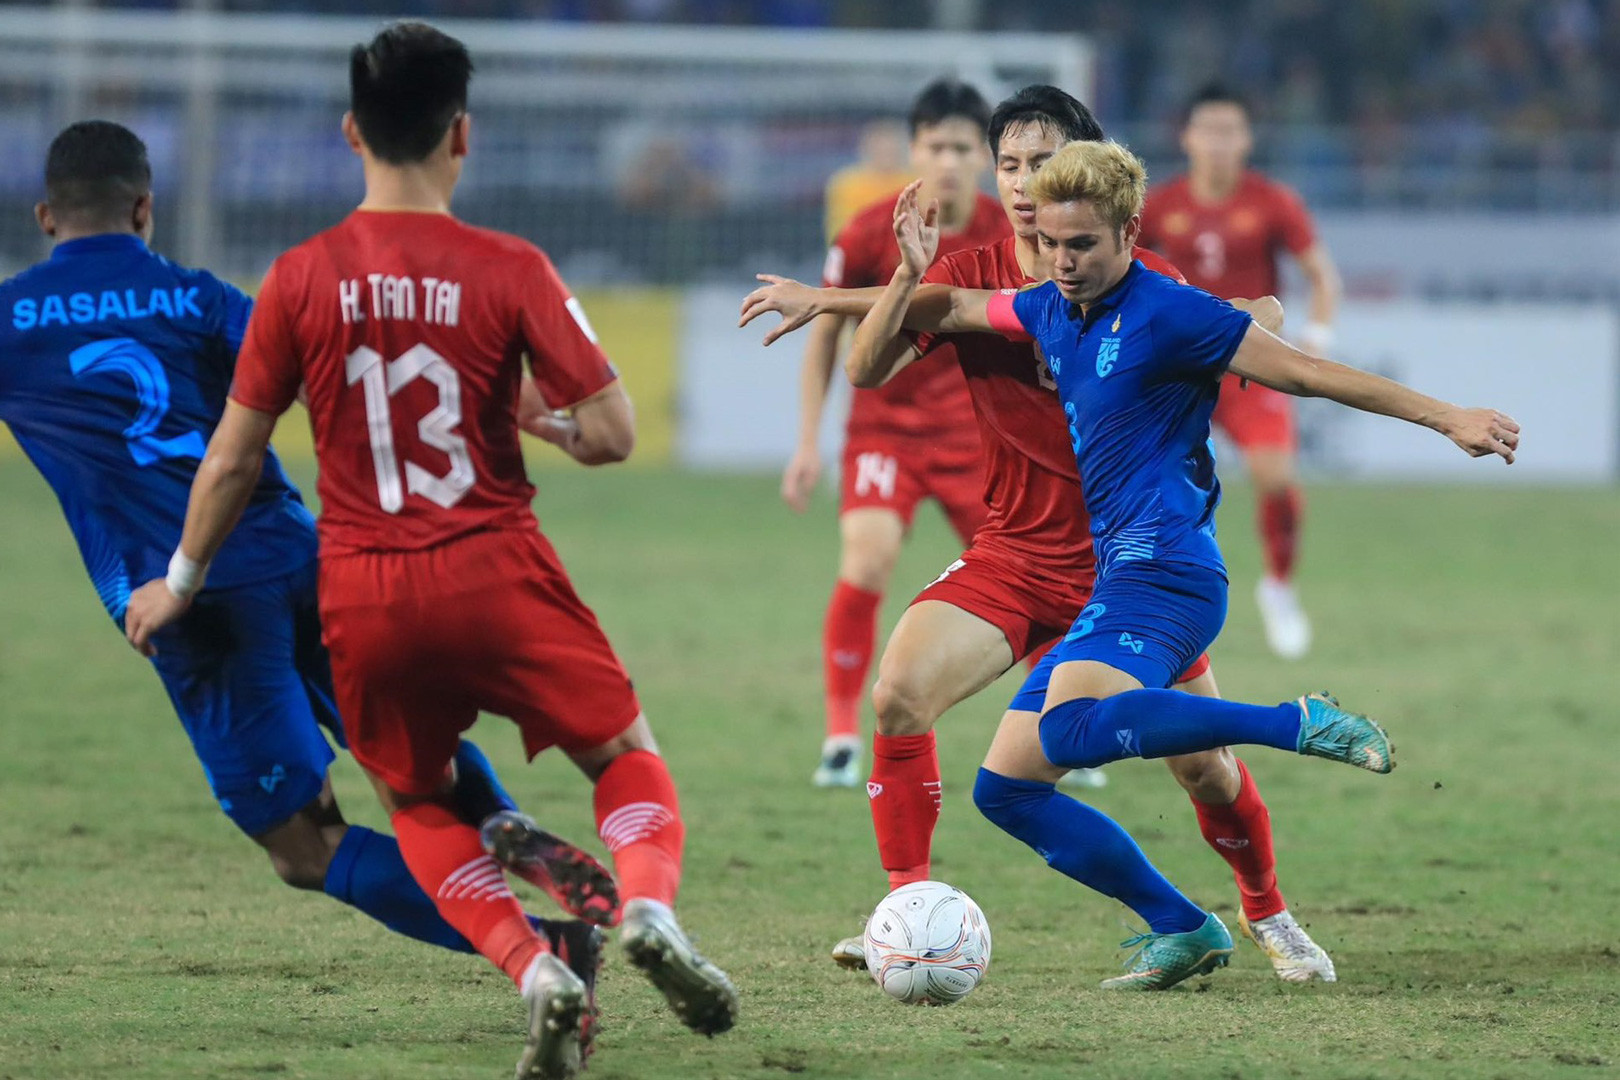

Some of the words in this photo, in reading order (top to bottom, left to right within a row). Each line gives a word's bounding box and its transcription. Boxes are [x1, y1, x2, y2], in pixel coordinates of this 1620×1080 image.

[12, 286, 202, 331] SASALAK
[339, 278, 366, 325] H.
[367, 273, 416, 321] TAN
[421, 277, 461, 327] TAI
[68, 337, 206, 467] 2
[345, 342, 475, 515] 13
[855, 452, 898, 498] 14
[1064, 602, 1106, 643] 3
